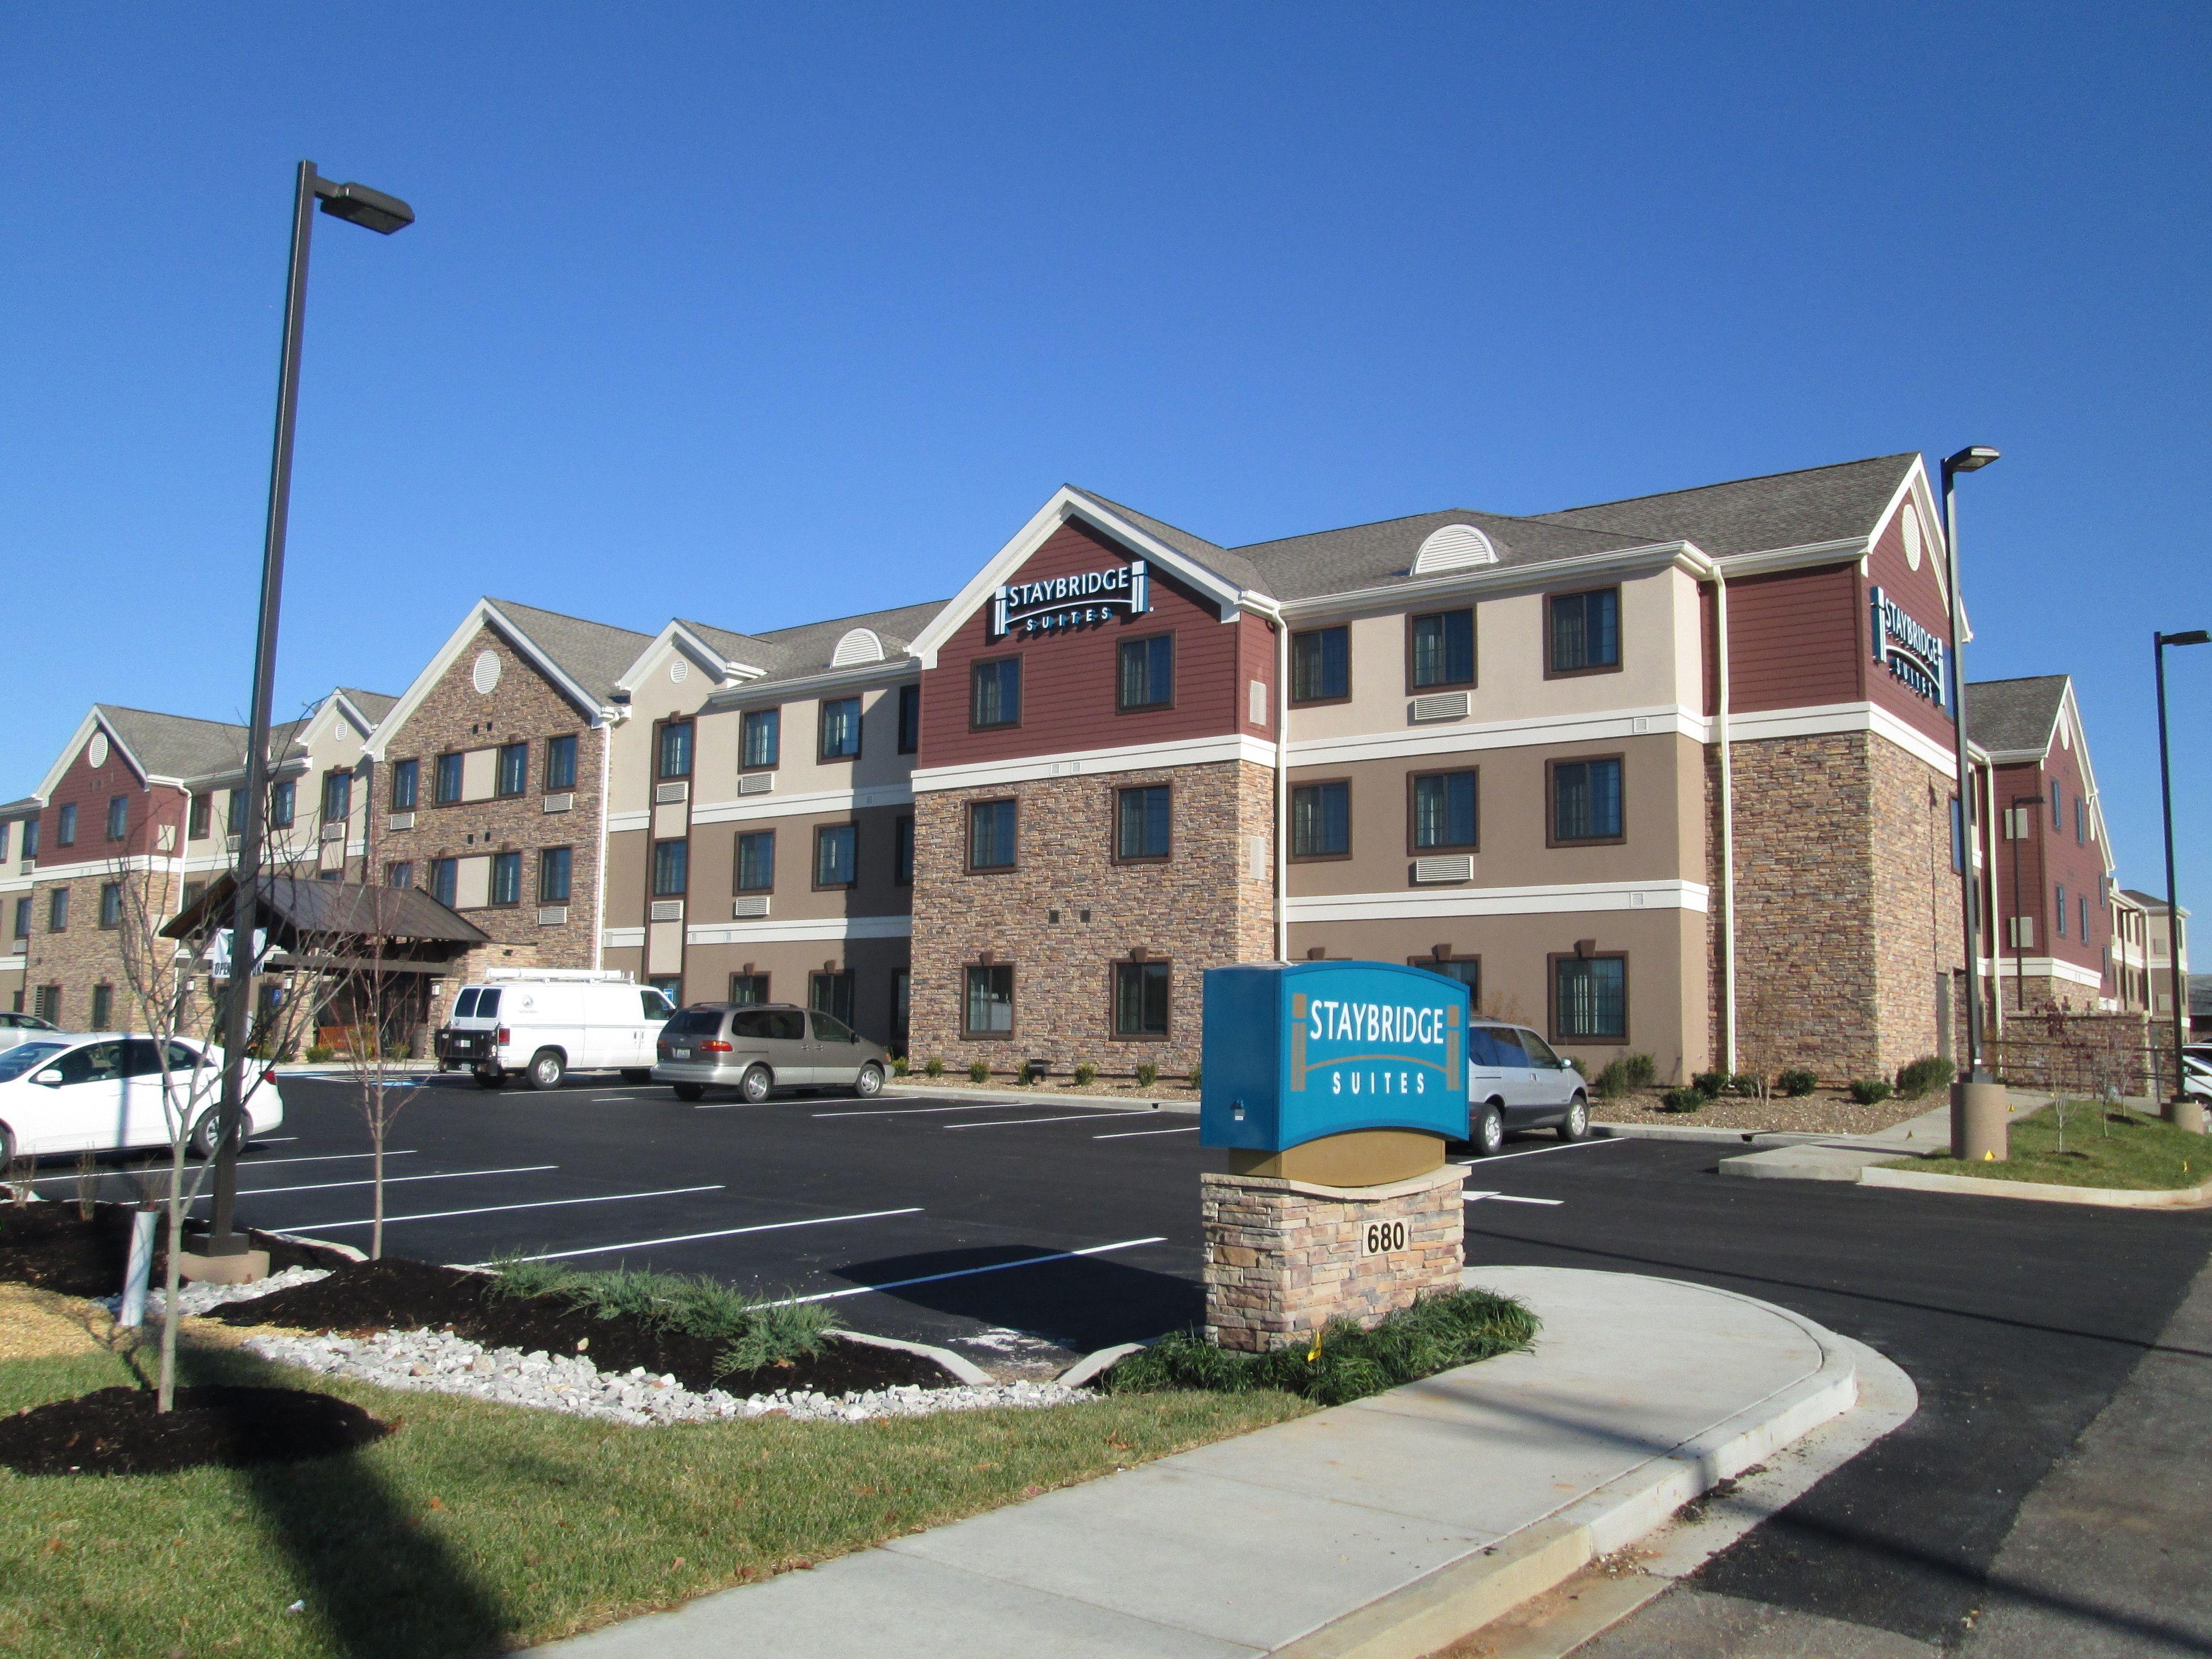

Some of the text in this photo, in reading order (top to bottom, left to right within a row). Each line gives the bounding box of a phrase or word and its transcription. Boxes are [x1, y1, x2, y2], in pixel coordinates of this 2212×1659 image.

[1010, 567, 1129, 607] STAYBRIDGE
[1027, 607, 1109, 631] SUITES
[1885, 597, 1938, 666] STAYBRIDGE
[1897, 657, 1933, 698] SUITES
[1310, 1000, 1444, 1044] STAYBRIDGE
[1332, 1071, 1425, 1094] SUITES
[1368, 1222, 1404, 1253] 680
